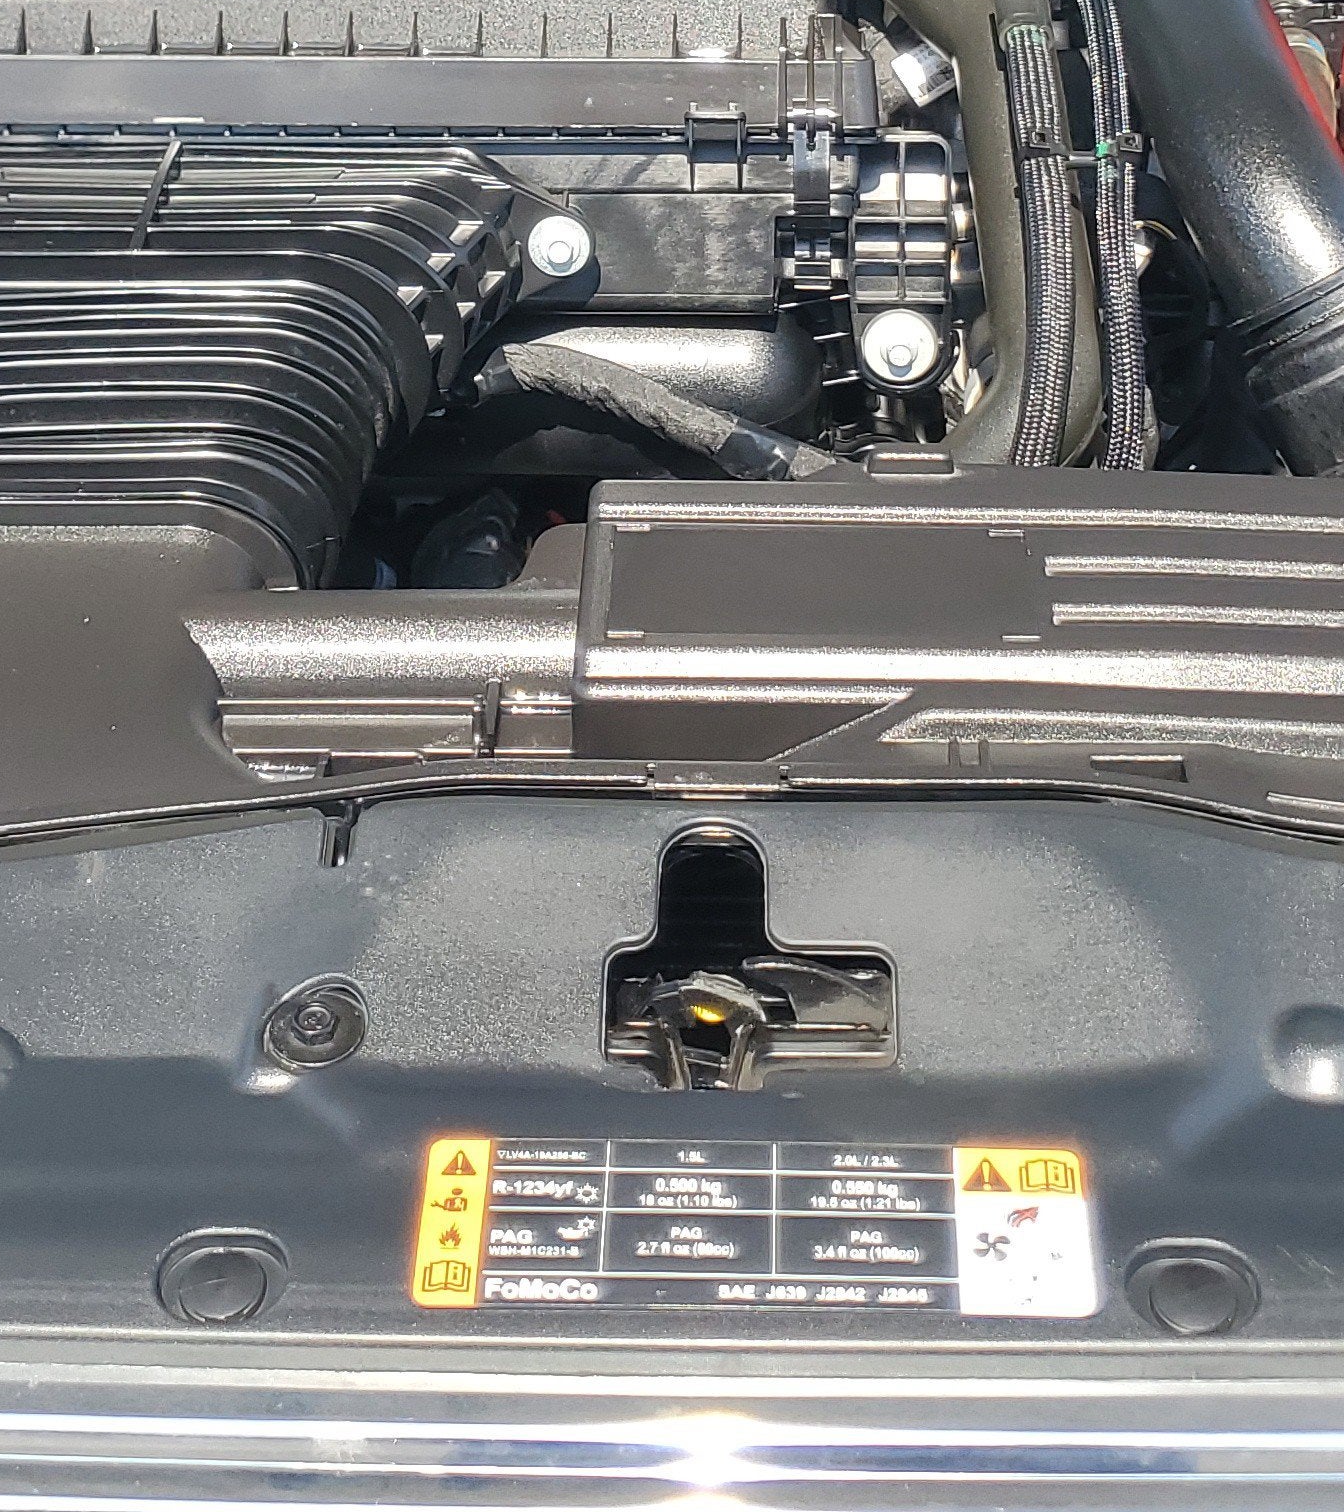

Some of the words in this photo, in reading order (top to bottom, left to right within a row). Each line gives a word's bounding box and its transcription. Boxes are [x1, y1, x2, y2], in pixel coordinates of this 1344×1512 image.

[492, 1179, 574, 1200] R-1234yf
[490, 1228, 534, 1245] PAG
[671, 1226, 703, 1239] PAG
[850, 1230, 883, 1244] PAG
[484, 1277, 598, 1300] FoMoCo
[718, 1284, 756, 1299] SAE
